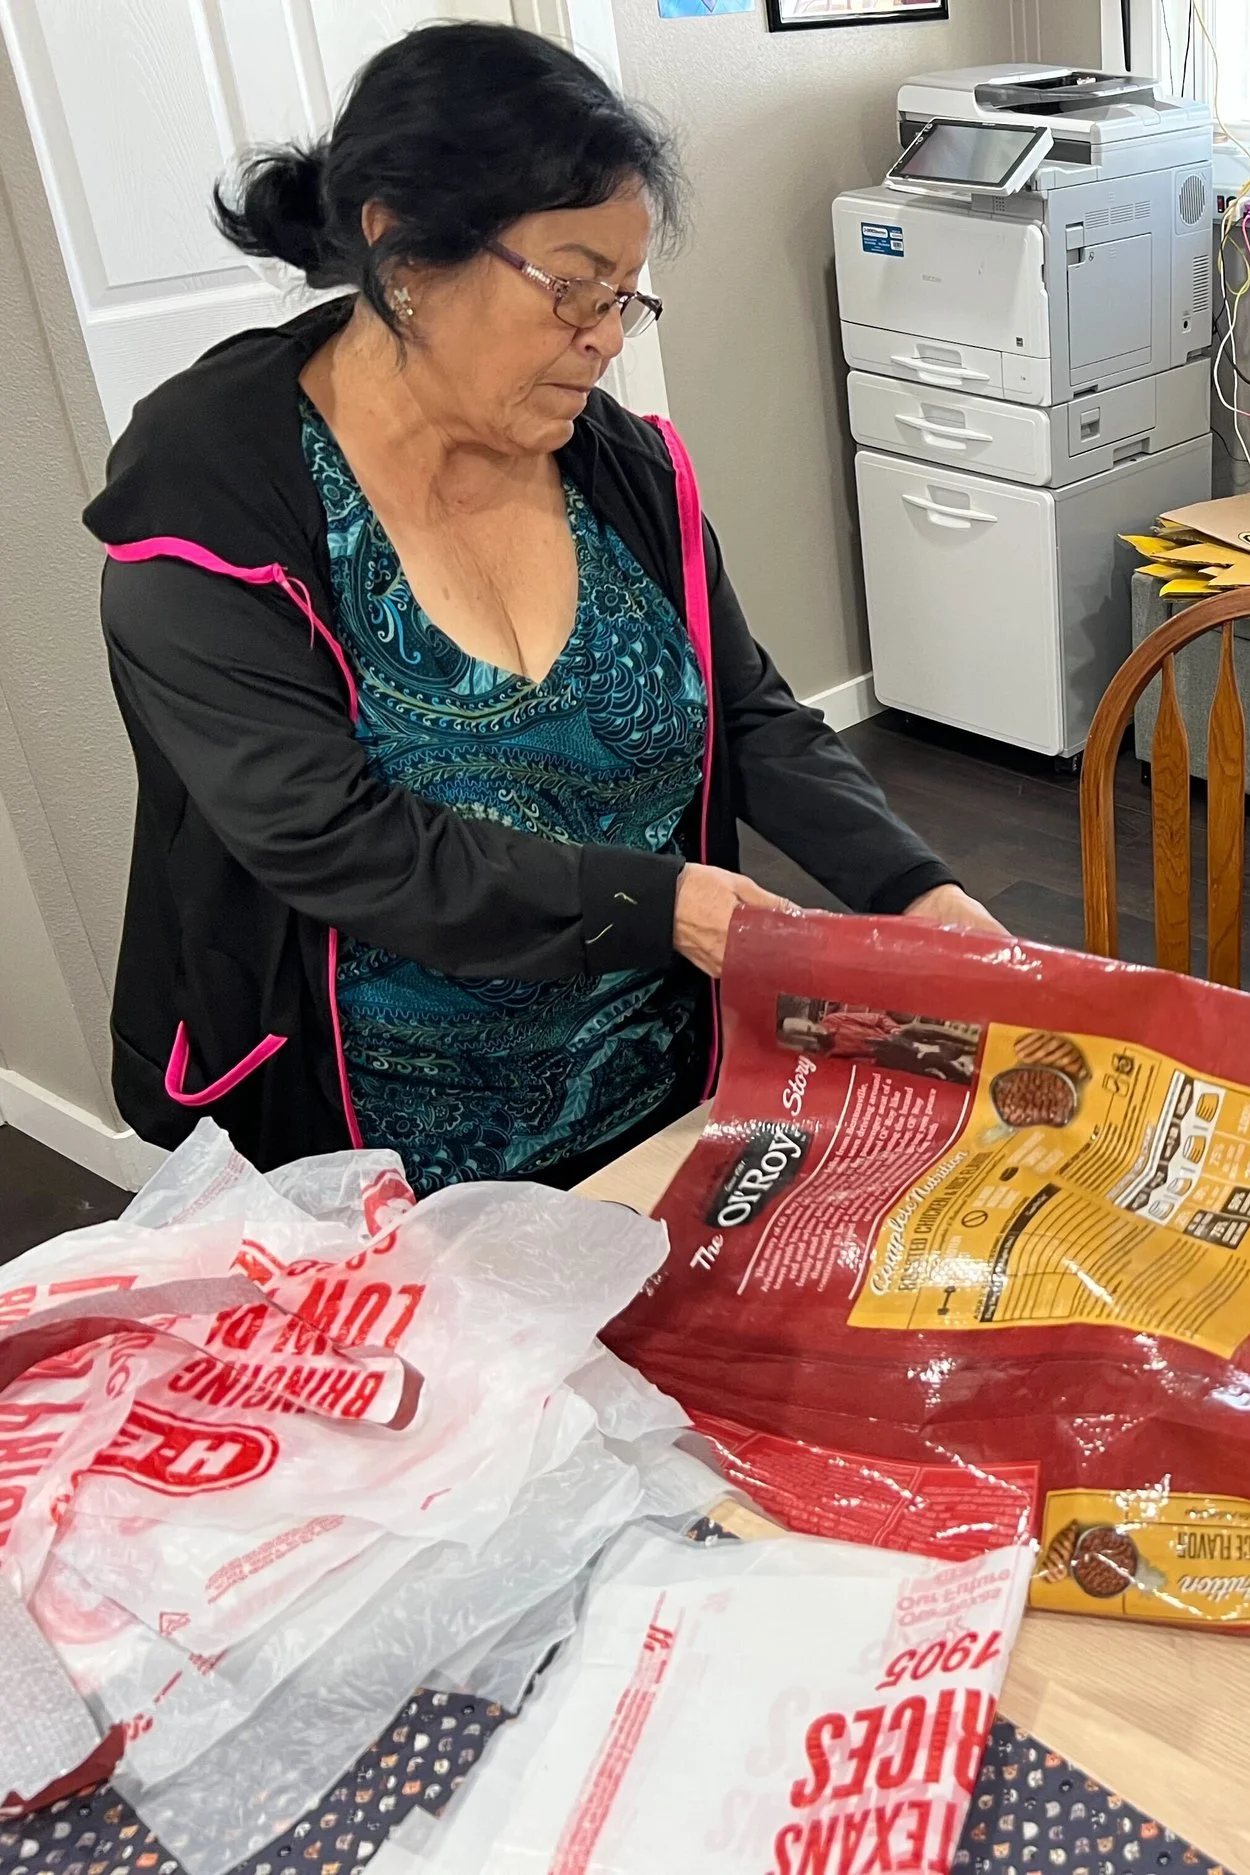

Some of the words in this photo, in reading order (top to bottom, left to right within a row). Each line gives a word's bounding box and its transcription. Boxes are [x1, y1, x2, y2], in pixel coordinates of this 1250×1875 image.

[836, 1136, 849, 1154] from
[846, 1083, 867, 1132] Bentonville,
[856, 1104, 874, 1136] driving
[868, 1073, 880, 1103] around
[860, 1116, 882, 1154] passenger
[877, 1095, 886, 1113] seat
[882, 1084, 890, 1094] of
[885, 1109, 896, 1125] Roy
[890, 1091, 900, 1107] like
[894, 1116, 904, 1130] the
[900, 1087, 912, 1114] brand
[912, 1097, 924, 1114] Roy
[920, 1115, 929, 1132] you
[925, 1088, 936, 1114] peace
[690, 1234, 724, 1270] The
[783, 1056, 817, 1116] Story
[870, 1206, 915, 1297] Complete
[905, 1150, 969, 1210] Nutrition
[914, 1197, 952, 1233] CHICKEN
[1210, 1218, 1228, 1238] 75%
[273, 1279, 427, 1356] LOW
[168, 1359, 387, 1421] BRINGING
[874, 1629, 1003, 1692] 1905
[790, 1688, 997, 1810] RICES
